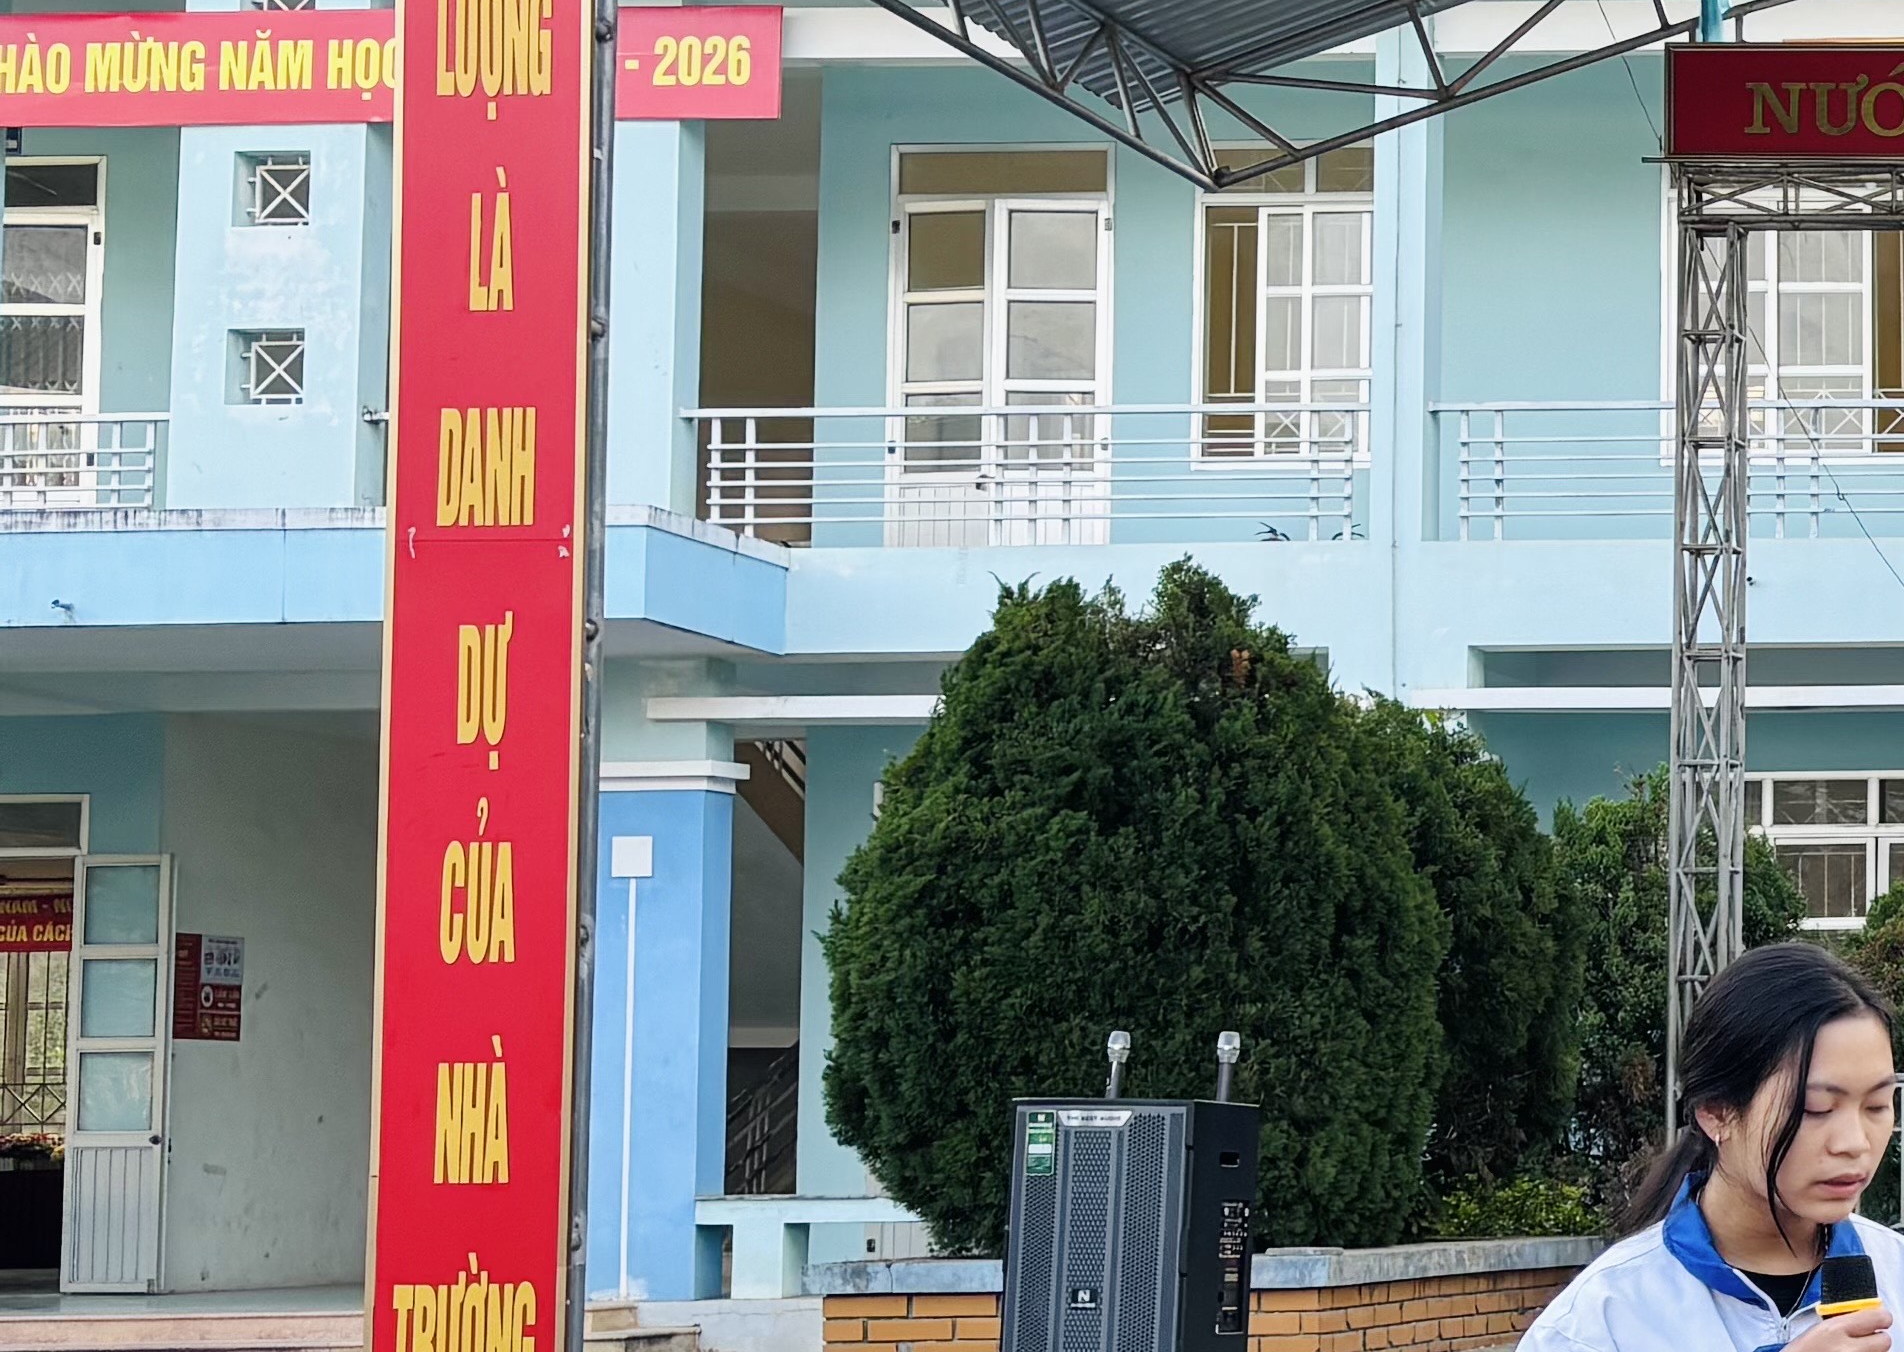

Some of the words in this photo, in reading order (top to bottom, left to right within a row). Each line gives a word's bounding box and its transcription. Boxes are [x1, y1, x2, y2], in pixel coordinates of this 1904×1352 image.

[84, 30, 206, 94] MỪNG
[218, 28, 314, 92] NĂM
[653, 35, 752, 87] 2026
[469, 167, 514, 312] LÀ
[436, 406, 537, 527] DANH
[457, 611, 513, 770] DỰ
[440, 797, 516, 964] CỦA
[434, 1035, 510, 1185] NHÀ
